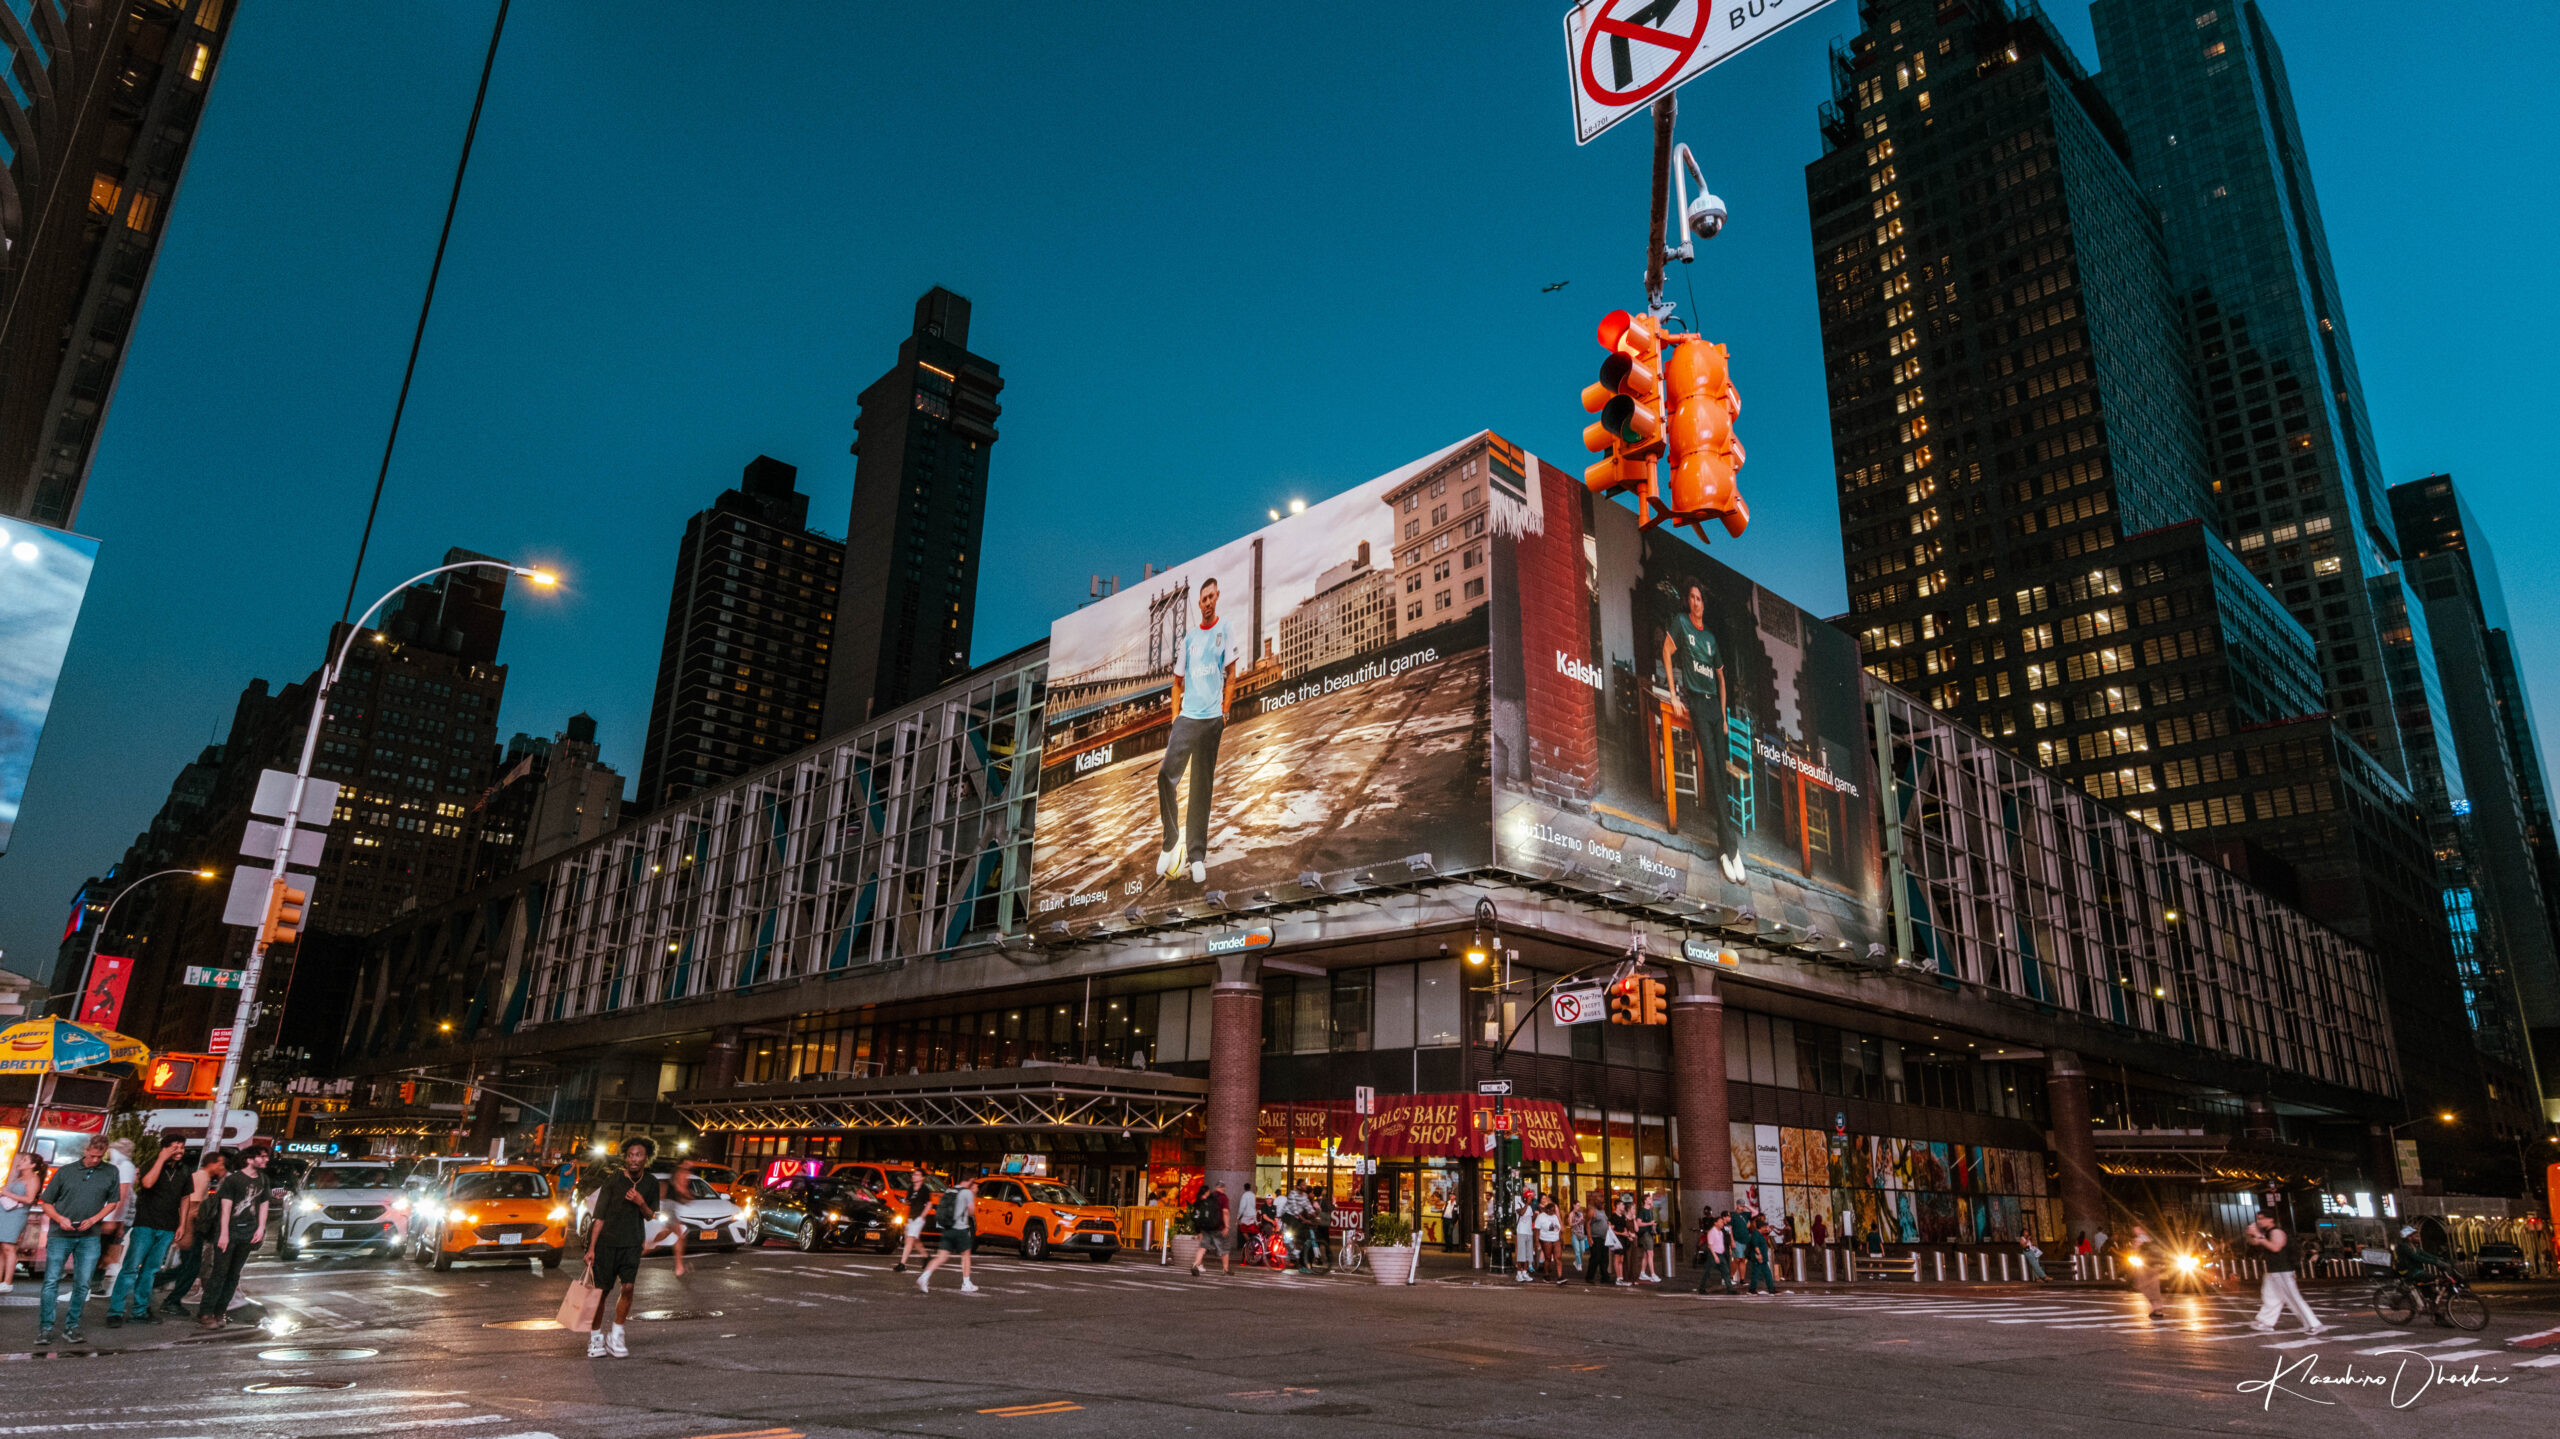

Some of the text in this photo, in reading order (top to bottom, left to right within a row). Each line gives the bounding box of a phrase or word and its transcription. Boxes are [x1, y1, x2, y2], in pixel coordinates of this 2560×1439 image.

[1260, 647, 1439, 713] Trade the beautiful game.
[1556, 650, 1603, 691] Kalshi
[1693, 660, 1714, 679] Kalshi
[1075, 743, 1112, 772] Kalshi
[1754, 738, 1860, 798] Trade the beautiful game.
[1517, 819, 1582, 851] Guillermo
[1588, 840, 1622, 863] Ochoa
[1639, 855, 1677, 878] Mexico
[1040, 880, 1143, 912] Clint Dempsey USA
[1209, 932, 1270, 952] brandedcities
[1687, 943, 1737, 966] branded
[201, 970, 240, 986] W 42 St
[1258, 1111, 1326, 1127] BAKE SHOP
[1358, 1106, 1411, 1141] CARLO'S
[1413, 1105, 1459, 1124] BAKE
[1523, 1109, 1560, 1129] BAKE
[1408, 1125, 1457, 1144] SHOP
[1527, 1129, 1565, 1149] SHOP
[288, 1143, 328, 1153] CHASE
